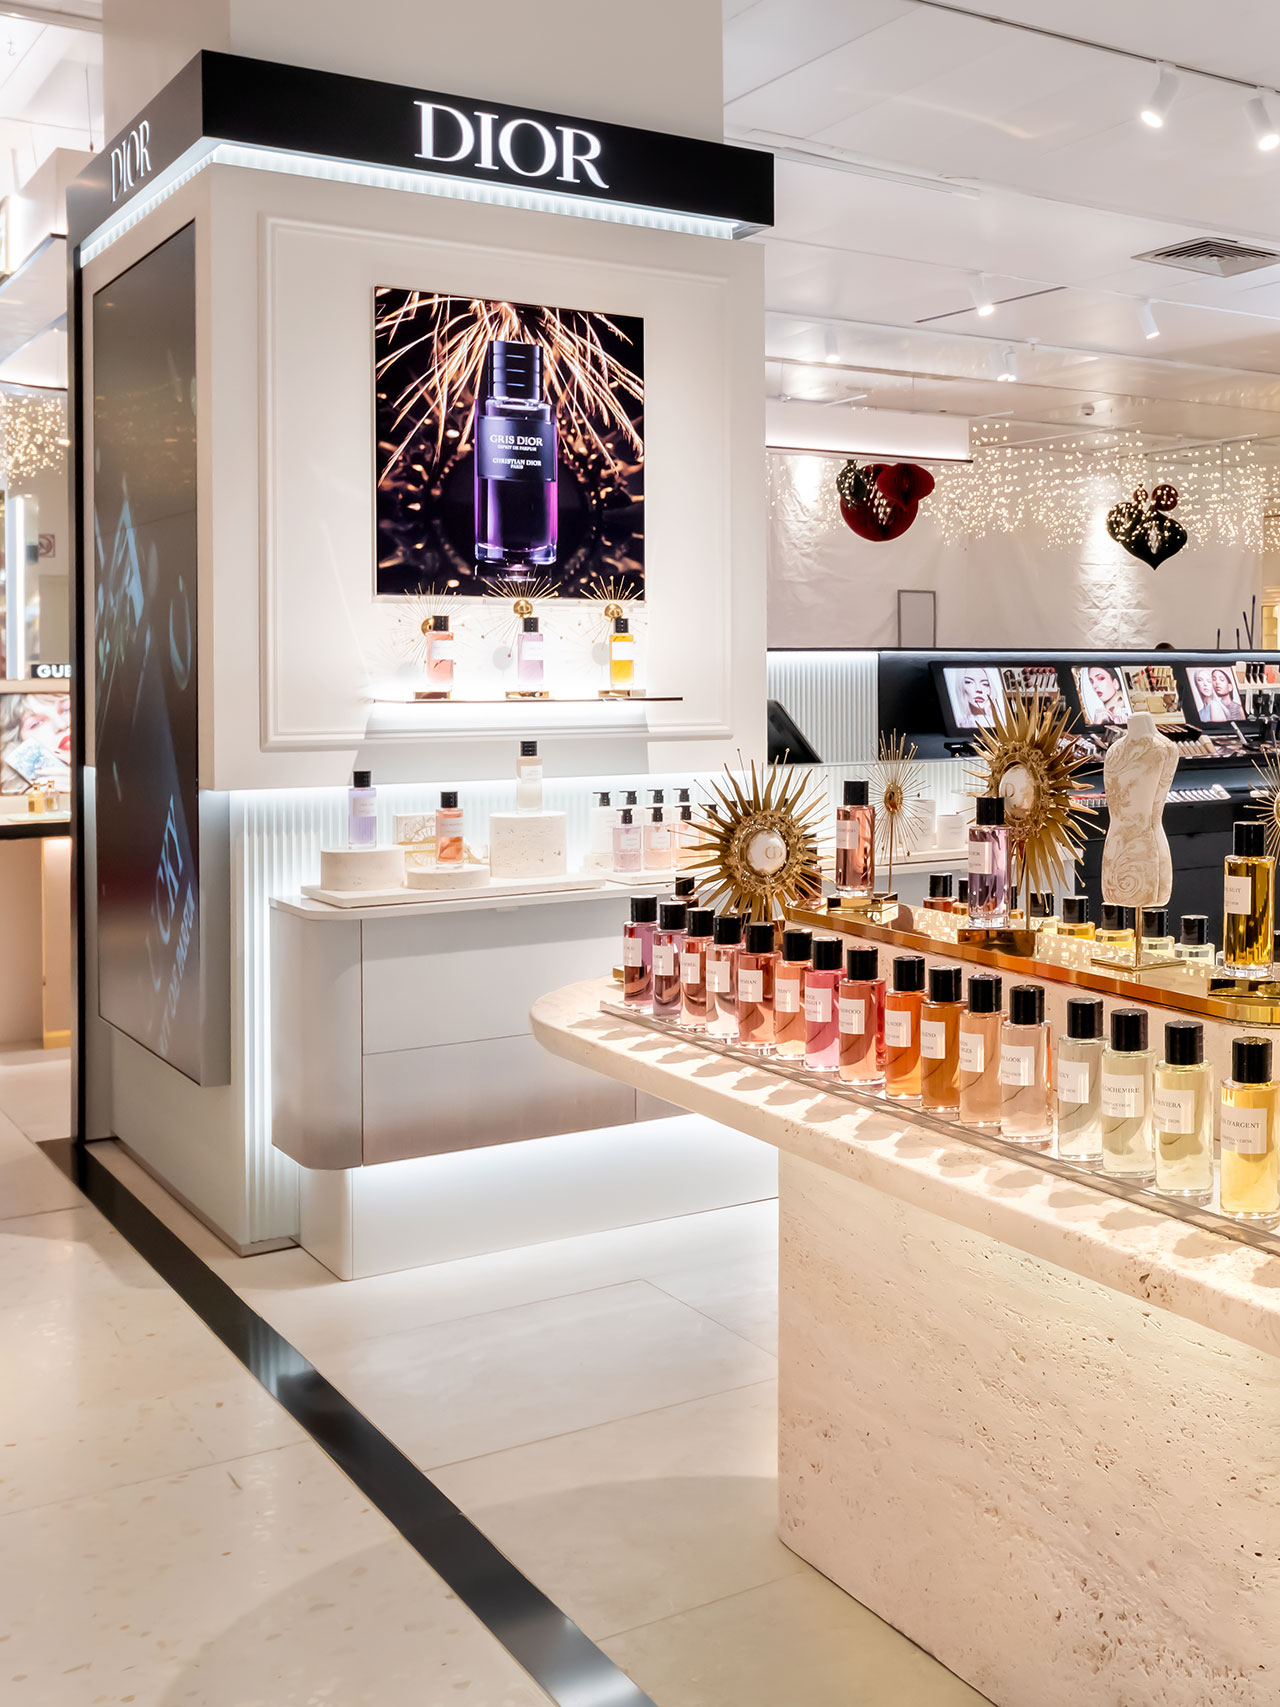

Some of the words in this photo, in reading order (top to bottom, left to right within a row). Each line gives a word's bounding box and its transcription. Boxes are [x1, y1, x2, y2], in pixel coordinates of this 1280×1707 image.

[110, 120, 152, 202] DIOR
[414, 101, 609, 189] DIOR
[490, 434, 515, 445] GRIS
[516, 436, 543, 447] DIOR
[492, 457, 525, 466] CHRISTIAN
[526, 459, 542, 467] DIOR
